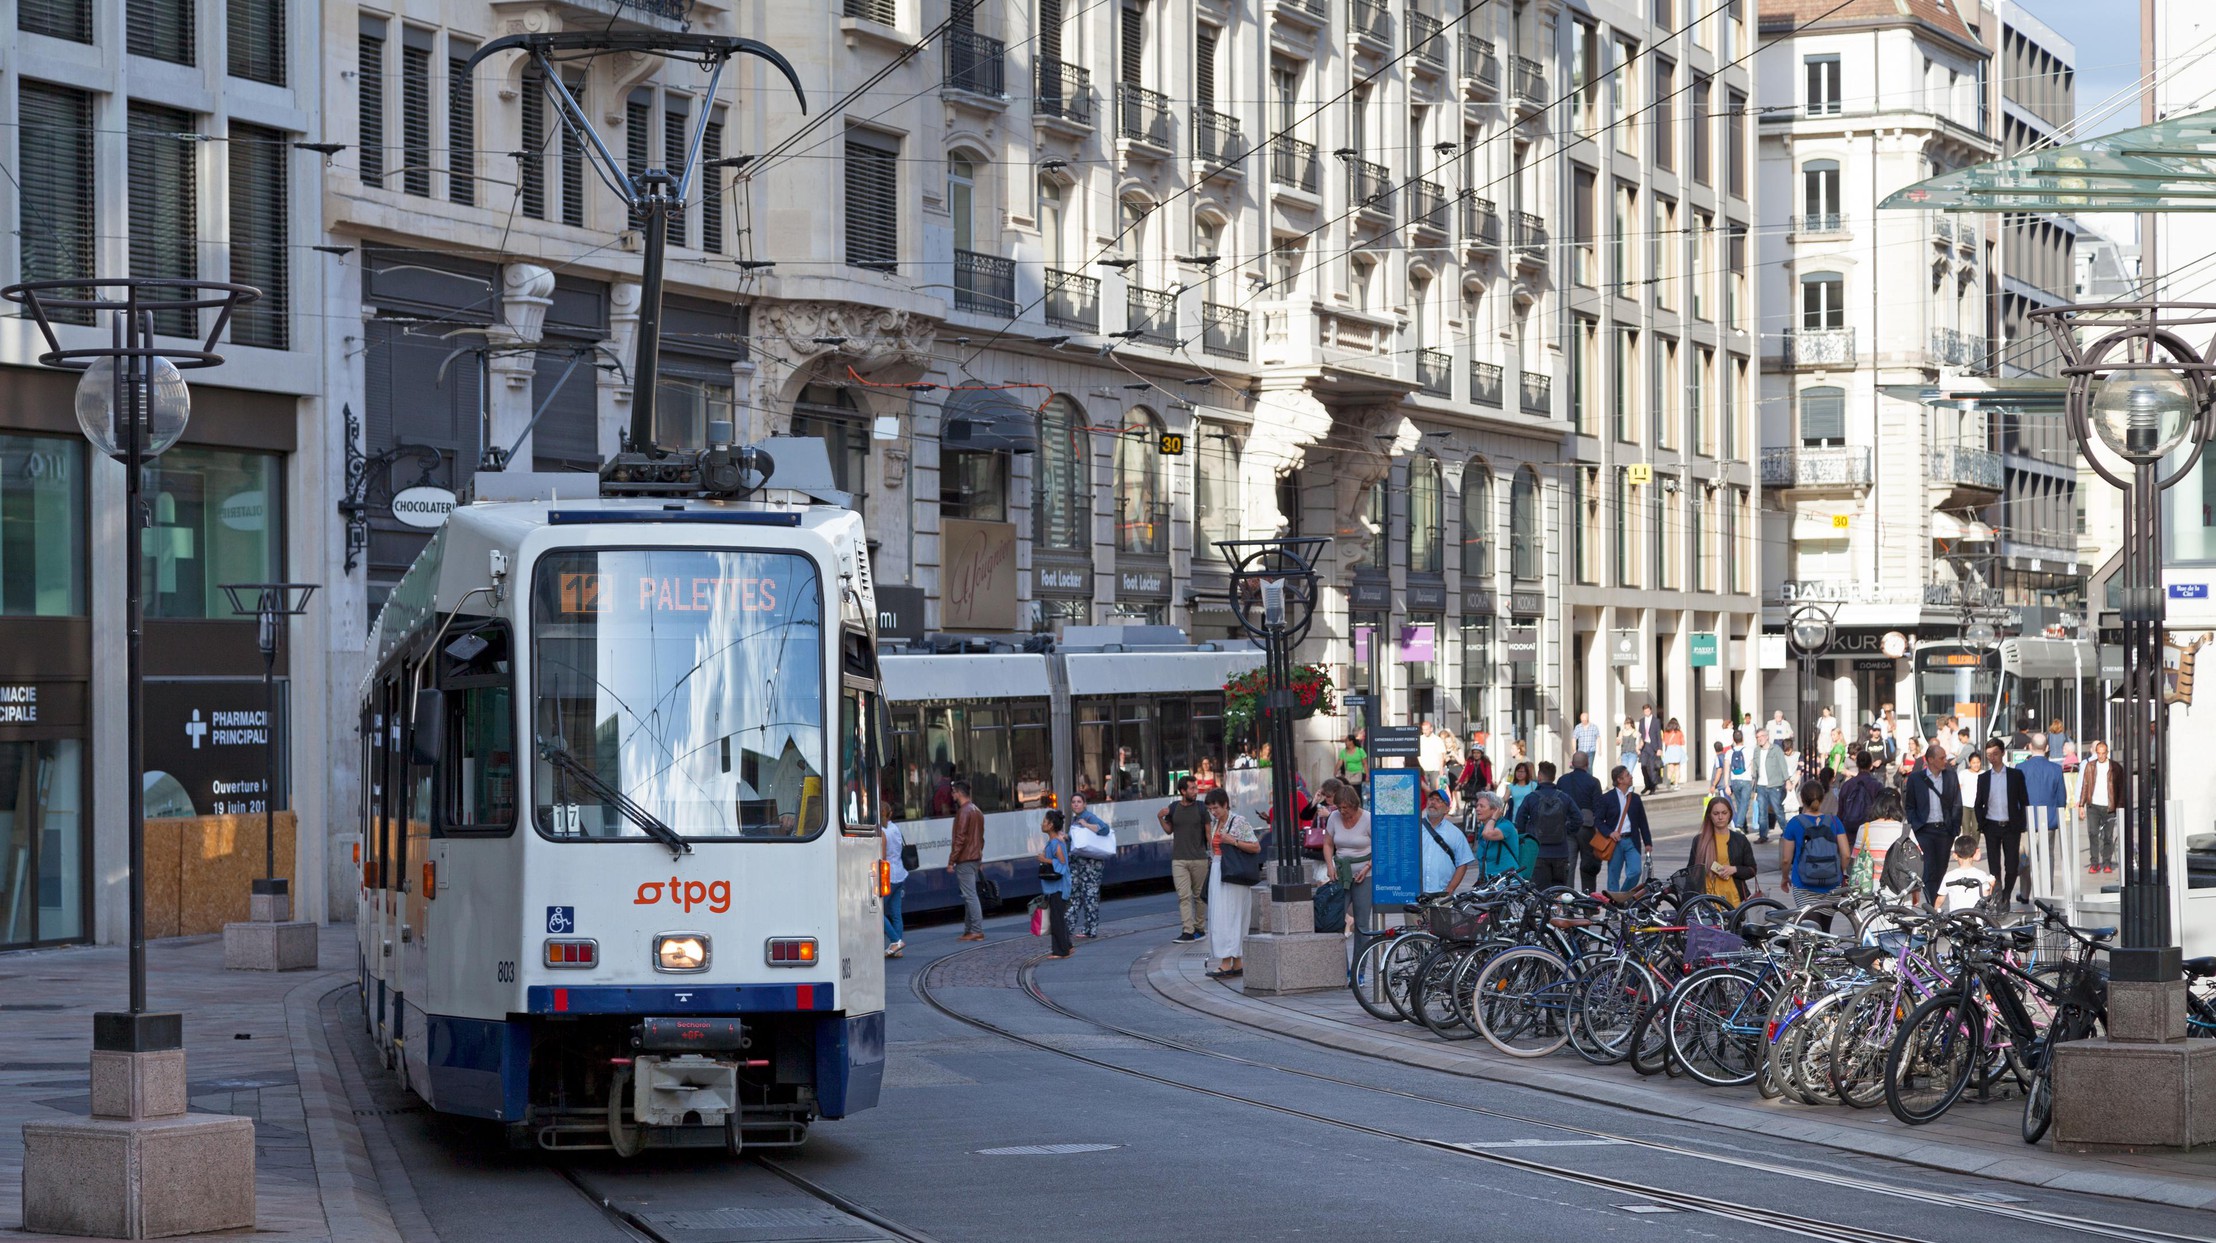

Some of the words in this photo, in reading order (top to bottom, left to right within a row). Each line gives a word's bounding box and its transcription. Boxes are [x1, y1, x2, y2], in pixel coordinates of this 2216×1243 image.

[1161, 436, 1182, 453] 30
[394, 501, 458, 514] CHOCOLATERI
[1041, 569, 1057, 587] Foot
[1059, 570, 1082, 588] Locker
[1123, 573, 1138, 590] Foot
[1140, 574, 1161, 591] Locker
[564, 575, 609, 611] 12
[639, 577, 776, 612] PALETTES
[1508, 642, 1536, 651] KOOKAÏ
[1832, 634, 1883, 651] KUR
[212, 711, 267, 726] PHARMACI
[212, 780, 260, 795] Ouverture
[213, 801, 225, 815] 19
[227, 801, 246, 814] juin
[249, 800, 266, 813] 201
[668, 876, 731, 914] tpg
[497, 960, 515, 983] 803
[841, 958, 852, 980] 803
